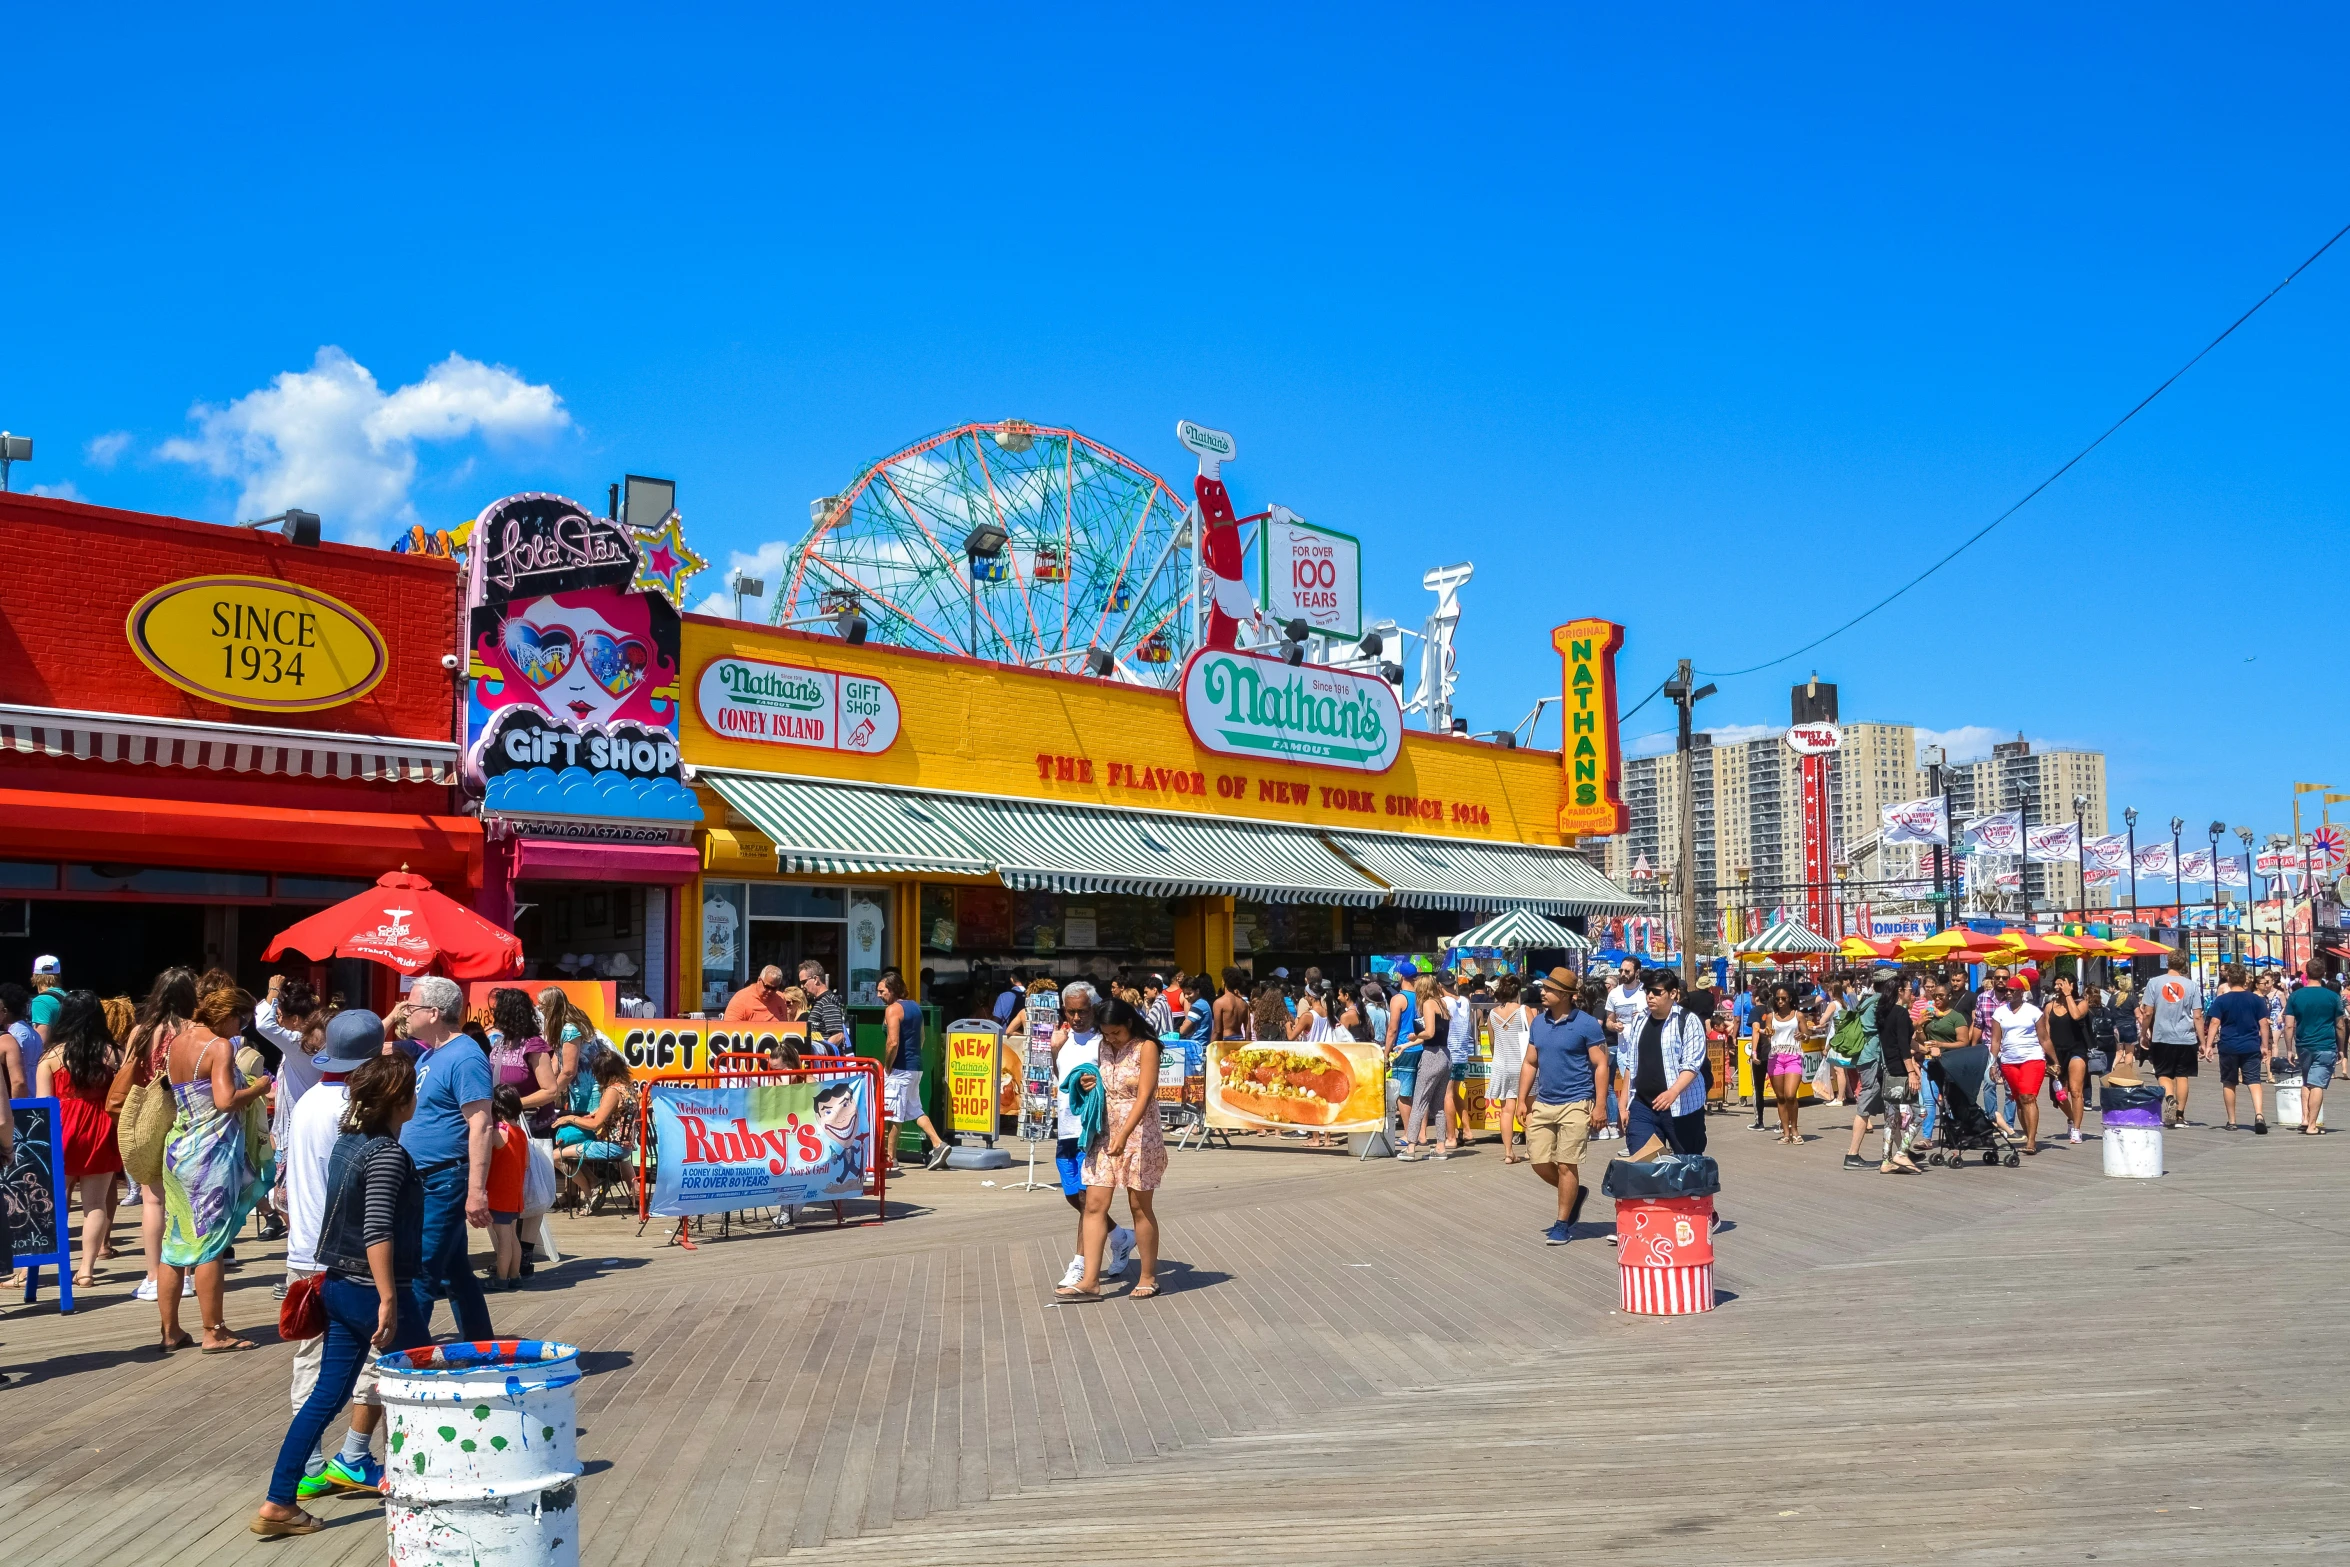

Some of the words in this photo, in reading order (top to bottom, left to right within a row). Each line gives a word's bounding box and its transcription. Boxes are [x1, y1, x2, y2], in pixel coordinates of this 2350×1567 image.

[1186, 425, 1230, 451] Nathan's
[1292, 546, 1310, 557] FOR
[1312, 547, 1333, 558] OVER
[1293, 559, 1336, 589] 100
[1293, 591, 1337, 608] YEARS
[212, 601, 316, 648] SINCE
[1558, 626, 1606, 640] ORIGINAL
[221, 643, 306, 686] 1934
[719, 663, 822, 702] Nathan's
[1312, 679, 1333, 693] Since
[1333, 683, 1350, 696] 1916
[846, 682, 881, 702] GIFT
[1204, 658, 1382, 743] Nathan's
[756, 699, 791, 708] FAMOUS
[846, 700, 881, 716] SHOP
[718, 707, 767, 735] CONEY
[772, 714, 824, 741] ISLAND
[1571, 639, 1597, 806] NATHANS
[1793, 731, 1822, 739] TWIST
[1825, 731, 1832, 739] &
[1807, 739, 1837, 747] SHOUT
[590, 737, 679, 773] SHOP
[1272, 739, 1330, 756] FAMOUS
[1036, 753, 1093, 784] THE
[1106, 761, 1207, 797] FLAVOR
[1217, 775, 1248, 800] OF
[1258, 778, 1310, 807] NEW
[1319, 786, 1377, 814] YORK
[1385, 794, 1443, 822] SINCE
[1451, 802, 1490, 826] 1916
[1568, 806, 1606, 816] FAMOUS
[1561, 814, 1613, 829] FRANKFURTERS
[1871, 923, 1919, 934] ONDER
[357, 947, 417, 967] #TakeTheRide
[953, 1038, 991, 1059] NEW
[951, 1061, 989, 1073] Nathan's
[955, 1077, 986, 1096] GIFT
[676, 1102, 718, 1116] Welcome
[719, 1106, 729, 1116] to
[951, 1097, 989, 1116] SHOP
[676, 1112, 824, 1176] Ruby's
[689, 1168, 711, 1176] CONEY
[712, 1168, 734, 1176] ISLAND
[736, 1167, 766, 1176] TRADITION
[789, 1167, 804, 1176] Bar
[805, 1166, 811, 1175] &
[813, 1163, 829, 1175] Grill
[682, 1177, 701, 1188] FOR
[703, 1177, 727, 1188] OVER
[728, 1177, 740, 1188] 80
[741, 1175, 770, 1187] YEARS
